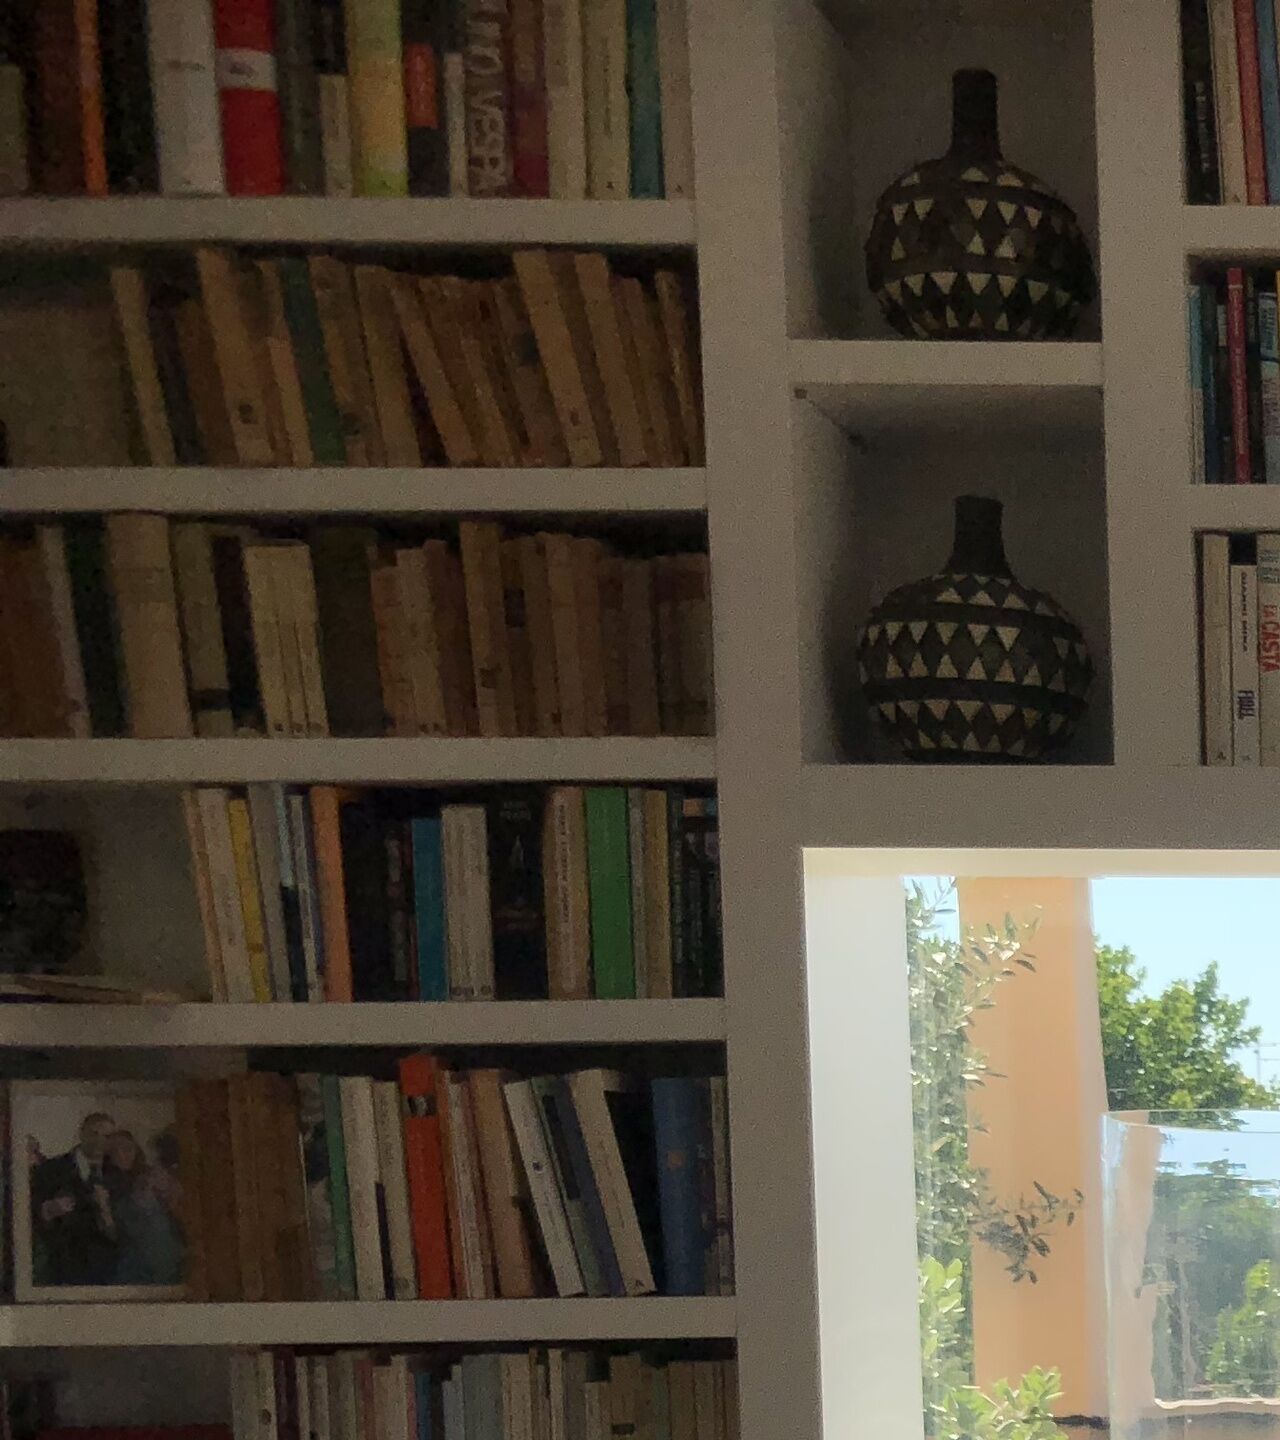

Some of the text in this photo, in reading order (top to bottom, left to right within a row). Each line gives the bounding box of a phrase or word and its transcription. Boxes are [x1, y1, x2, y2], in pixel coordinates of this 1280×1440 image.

[468, 91, 508, 197] VESPA
[1261, 621, 1280, 673] CASTA
[1238, 690, 1256, 720] FIDEL
